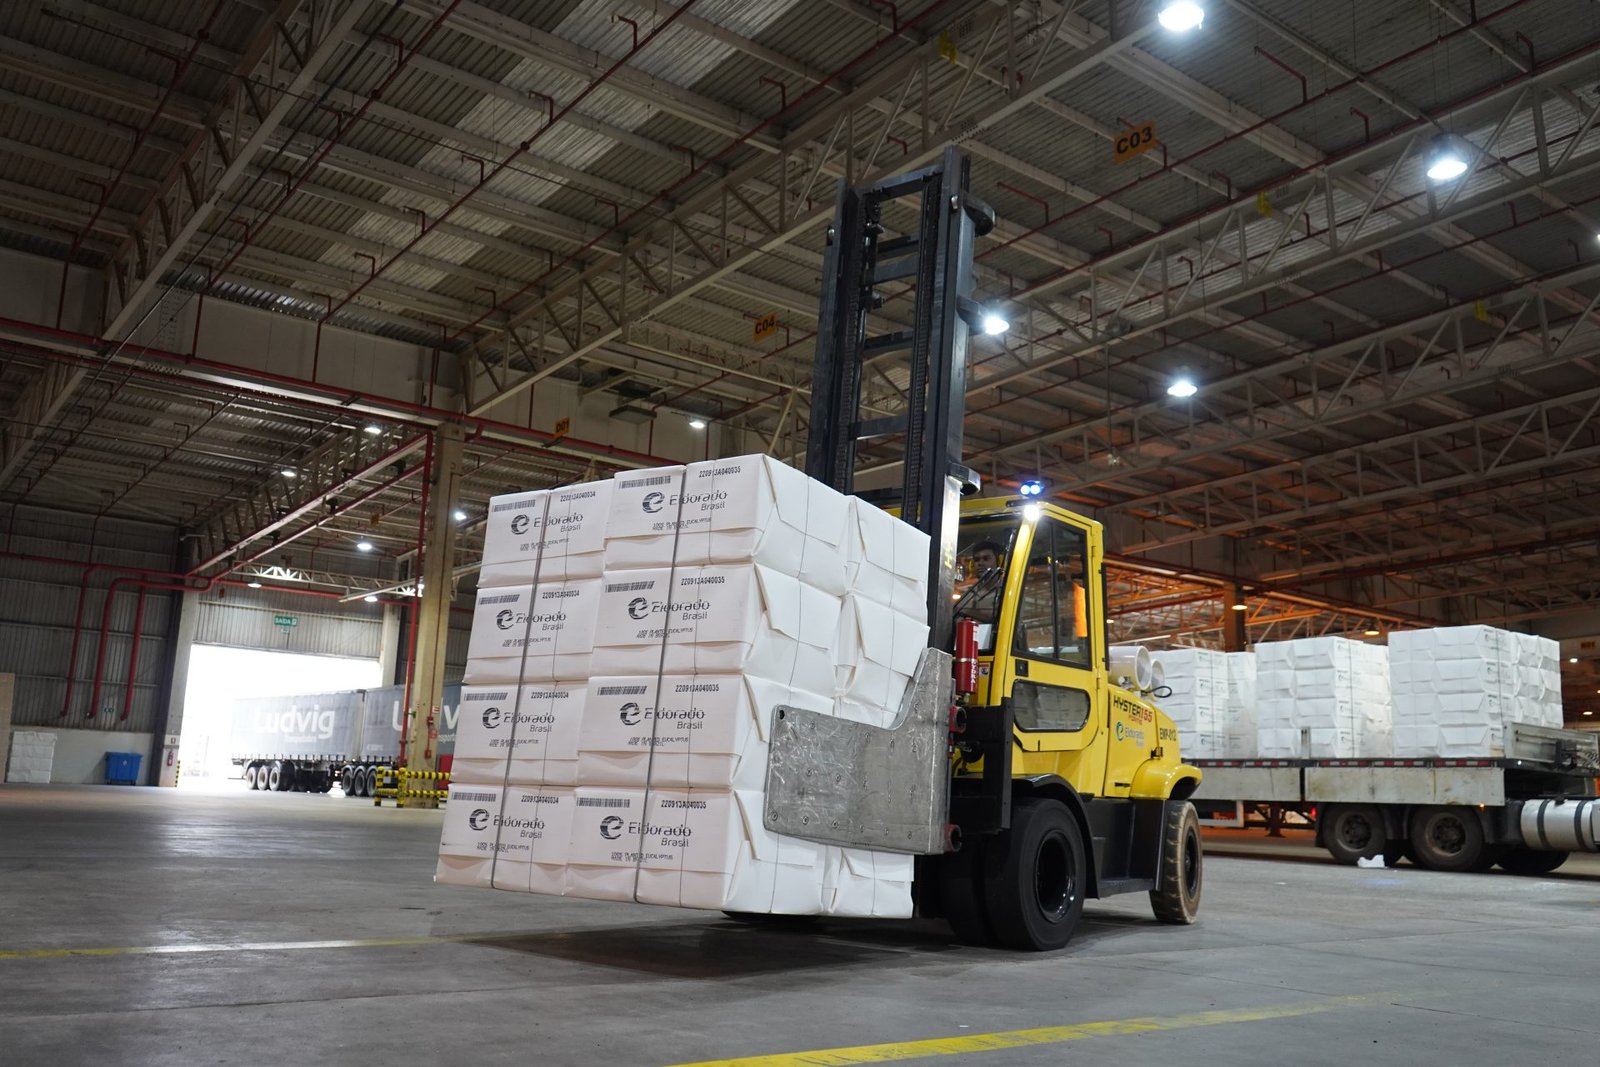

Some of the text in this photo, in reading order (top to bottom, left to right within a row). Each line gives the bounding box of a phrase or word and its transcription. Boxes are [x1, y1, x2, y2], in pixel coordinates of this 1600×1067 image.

[1117, 126, 1152, 154] C03
[701, 501, 726, 511] Brasil
[682, 612, 708, 621] Brasil
[542, 623, 564, 631] Brasil
[1113, 695, 1153, 723] HYSTER 155
[255, 704, 335, 740] Ludvig
[676, 721, 703, 730] Brasil
[529, 724, 552, 733] Brasil
[520, 829, 542, 839] Brasil
[661, 838, 689, 848] Brasil
